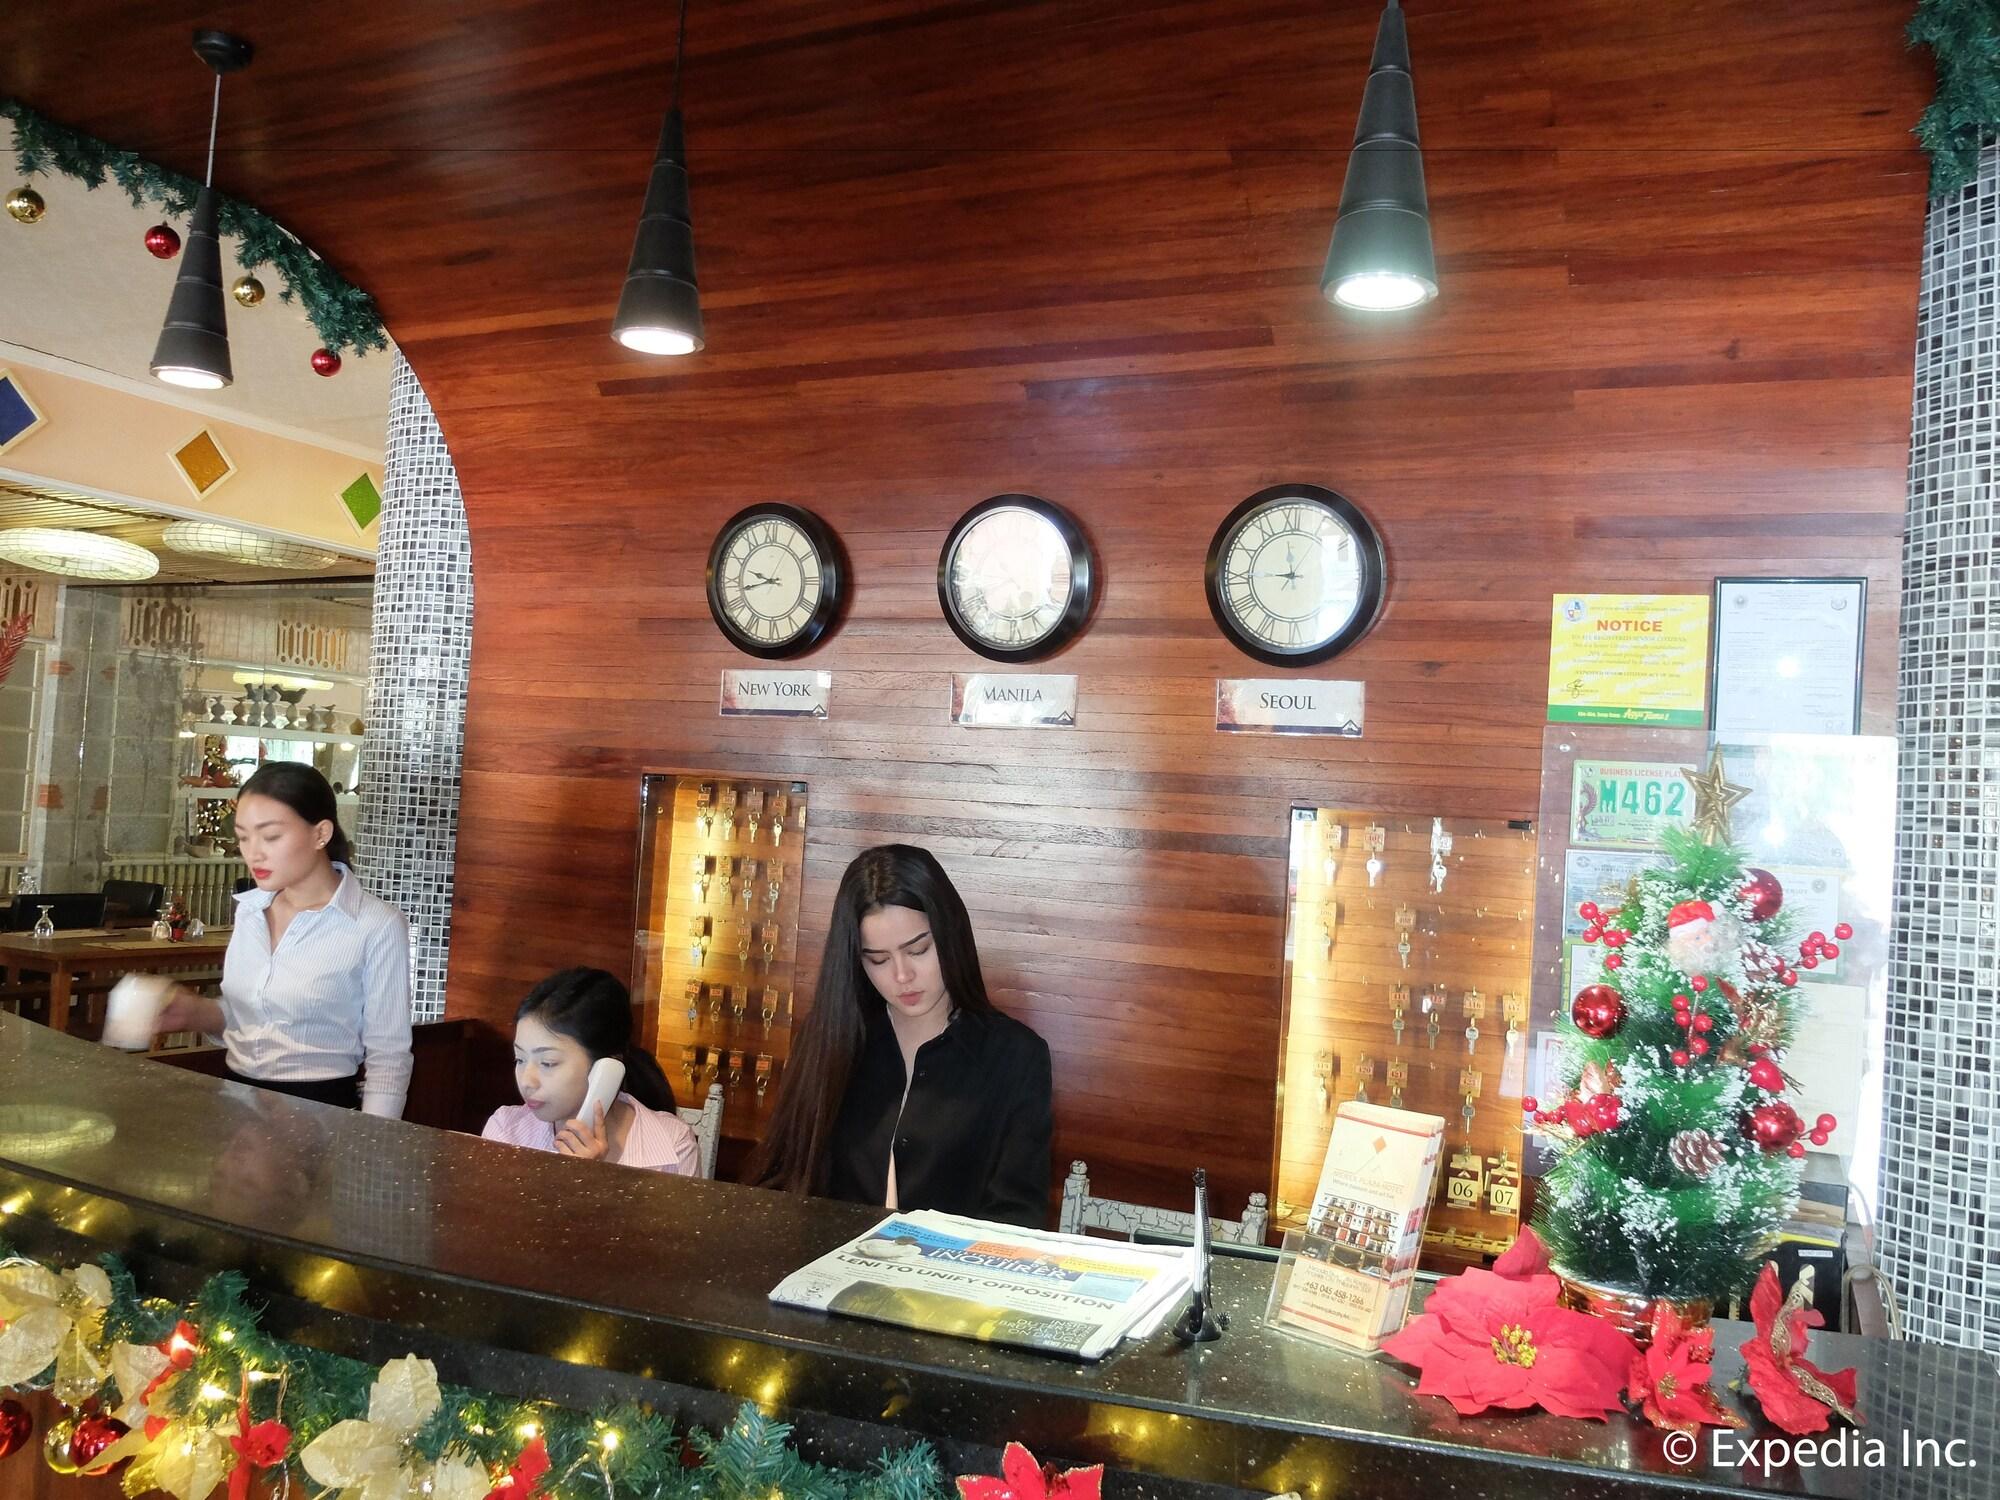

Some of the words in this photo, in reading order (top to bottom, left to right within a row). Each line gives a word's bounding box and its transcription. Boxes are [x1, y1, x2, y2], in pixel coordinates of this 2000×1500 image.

[1596, 619, 1663, 633] NOTICE
[738, 681, 770, 696] NEW
[772, 681, 812, 697] YORK
[983, 686, 1044, 702] MANILA
[1260, 692, 1317, 710] SEOUL
[1600, 767, 1633, 777] BUSINESS
[1634, 768, 1664, 777] LICENSE
[1664, 768, 1682, 778] PLAT
[1600, 779, 1686, 816] M462
[1453, 1181, 1473, 1198] 06
[1494, 1189, 1514, 1206] 07
[928, 1249, 1067, 1280] INQUIRER
[835, 1254, 882, 1270] LENI
[885, 1263, 914, 1273] TO
[916, 1267, 980, 1284] UNIFY
[982, 1280, 1115, 1310] OPPOSITION
[1049, 1319, 1097, 1330] INSIDE
[1007, 1327, 1031, 1336] ON
[1032, 1331, 1086, 1344] DRUGS
